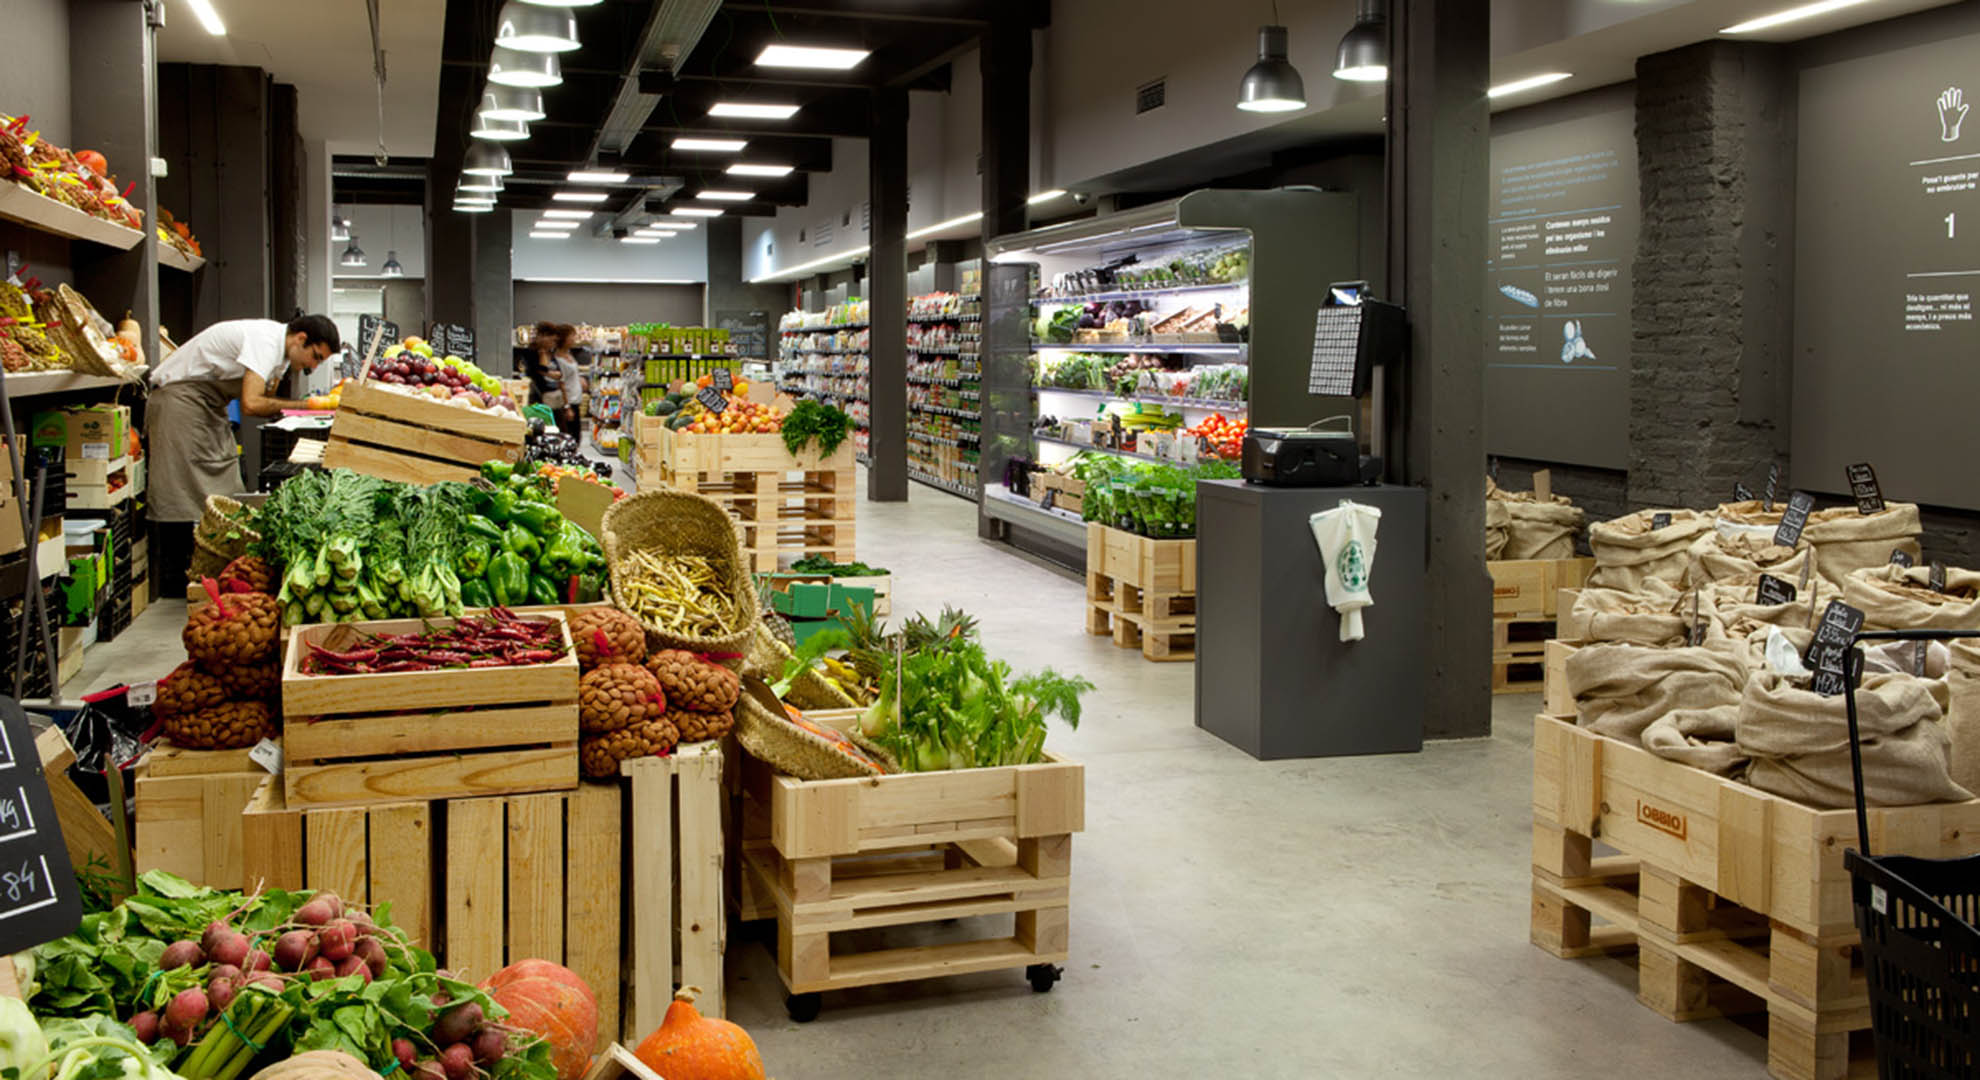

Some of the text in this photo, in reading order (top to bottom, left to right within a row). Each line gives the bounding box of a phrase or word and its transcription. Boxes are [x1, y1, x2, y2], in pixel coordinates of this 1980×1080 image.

[1944, 212, 1955, 238] 1
[1586, 270, 1595, 278] de
[1642, 804, 1681, 830] OBBIO
